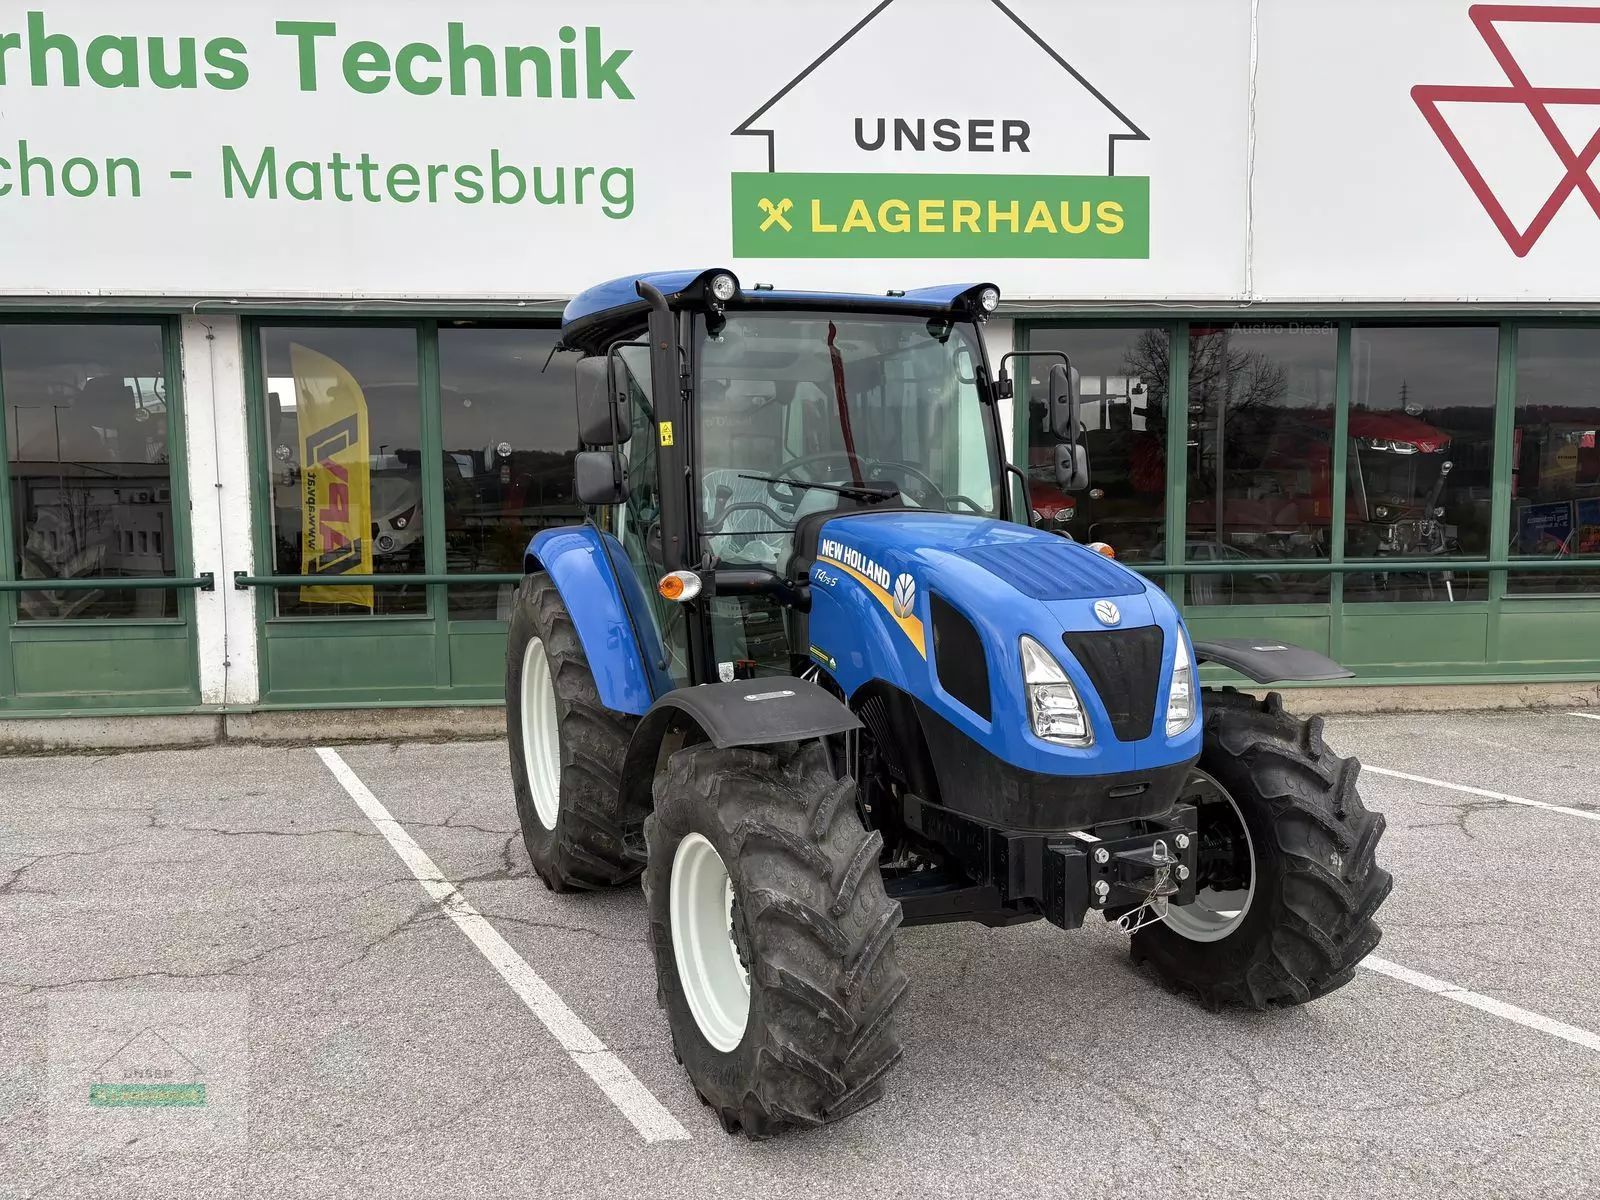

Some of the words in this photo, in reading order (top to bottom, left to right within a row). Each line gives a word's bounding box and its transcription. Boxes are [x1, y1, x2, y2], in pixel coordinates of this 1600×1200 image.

[276, 20, 635, 101] Technik
[854, 117, 1031, 153] UNSER
[223, 146, 634, 219] Mattersburg
[811, 199, 1124, 235] LAGERHAUS
[1231, 322, 1283, 335] Austro
[822, 538, 844, 561] NEW
[843, 546, 891, 590] HOLLAND
